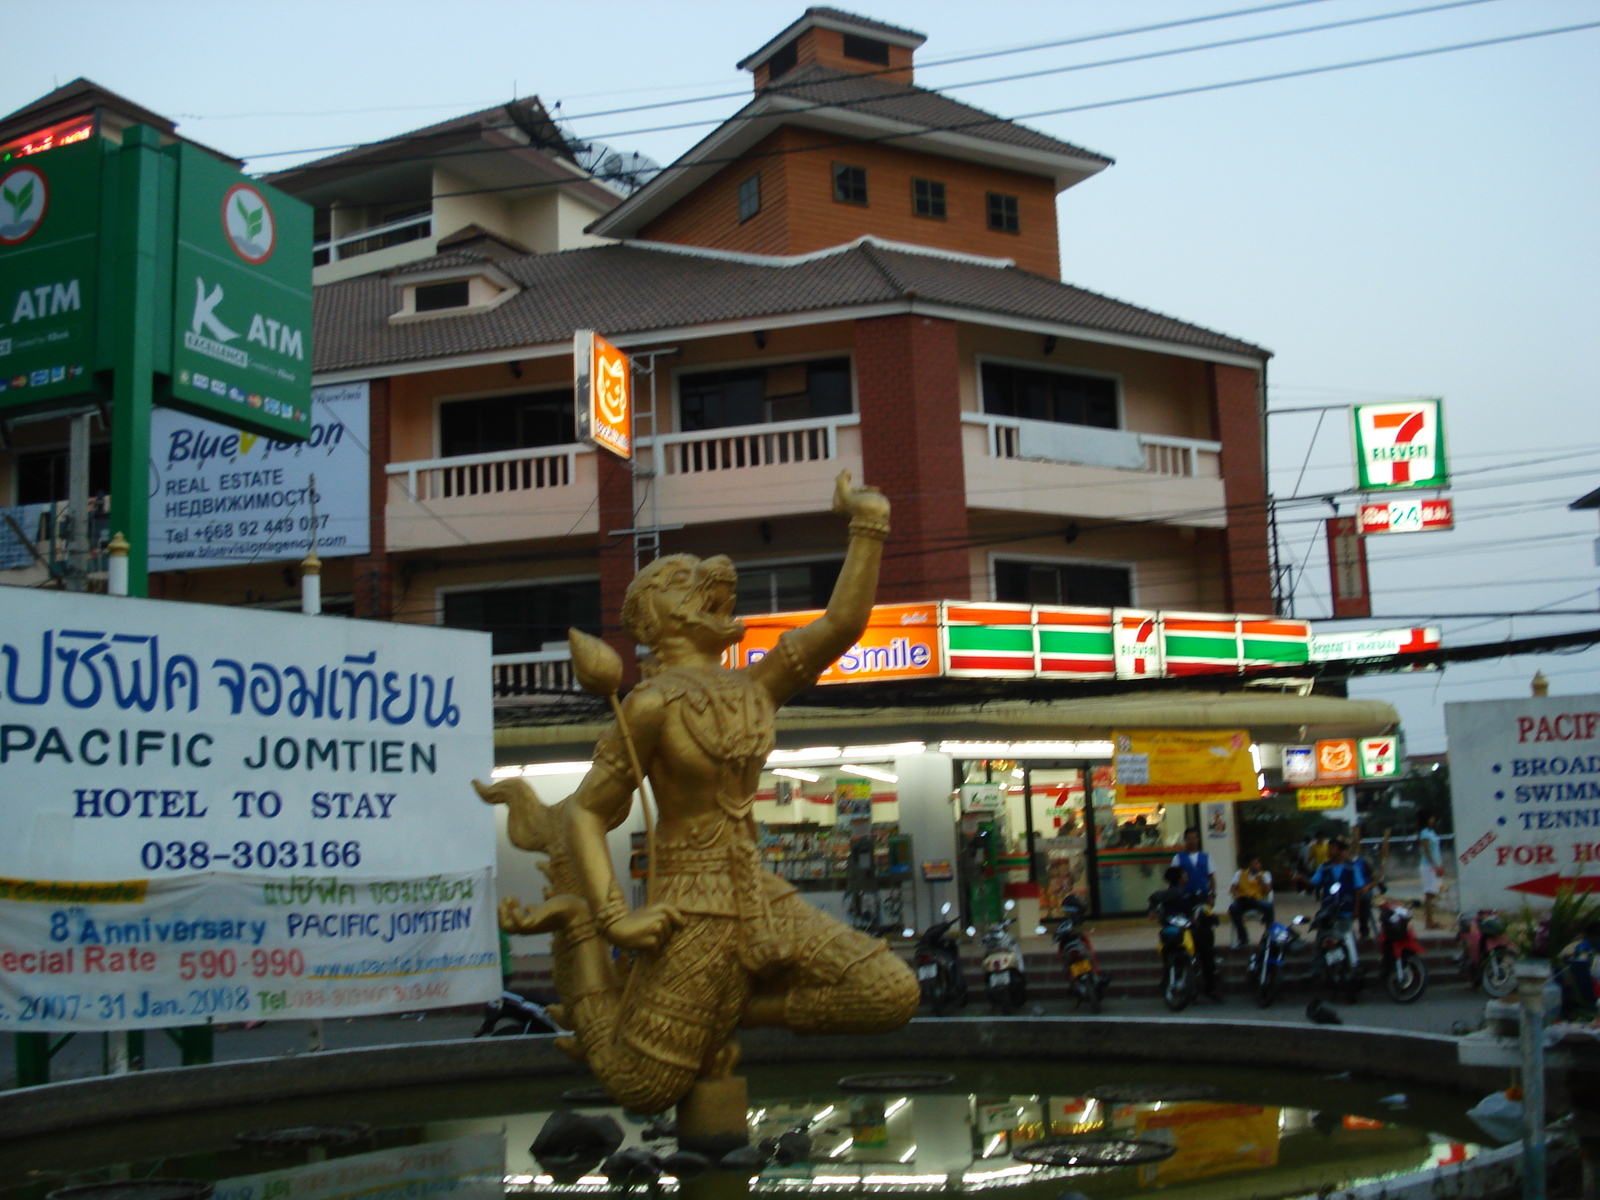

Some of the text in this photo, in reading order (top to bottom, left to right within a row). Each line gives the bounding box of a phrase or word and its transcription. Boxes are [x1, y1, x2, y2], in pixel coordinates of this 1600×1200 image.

[12, 279, 81, 324] ATM
[191, 276, 304, 361] K ATM
[165, 469, 284, 498] REAL ESTATE
[165, 527, 188, 543] Tel
[238, 520, 258, 537] 92
[264, 518, 294, 533] 449
[839, 637, 931, 673] Smile
[211, 651, 460, 728] จอมเทียน
[0, 725, 438, 775] PACIFIC JOMTIEN
[73, 789, 398, 821] HOTEL TO STAY
[141, 840, 361, 871] 038-303166
[1495, 844, 1556, 866] FOR
[79, 916, 267, 945] Anniversary
[287, 908, 472, 942] PACIFIC JOMTEIN
[84, 946, 157, 974] Rate
[179, 948, 305, 981] 590-990
[133, 991, 185, 1018] Jan.
[188, 986, 250, 1014] 2008
